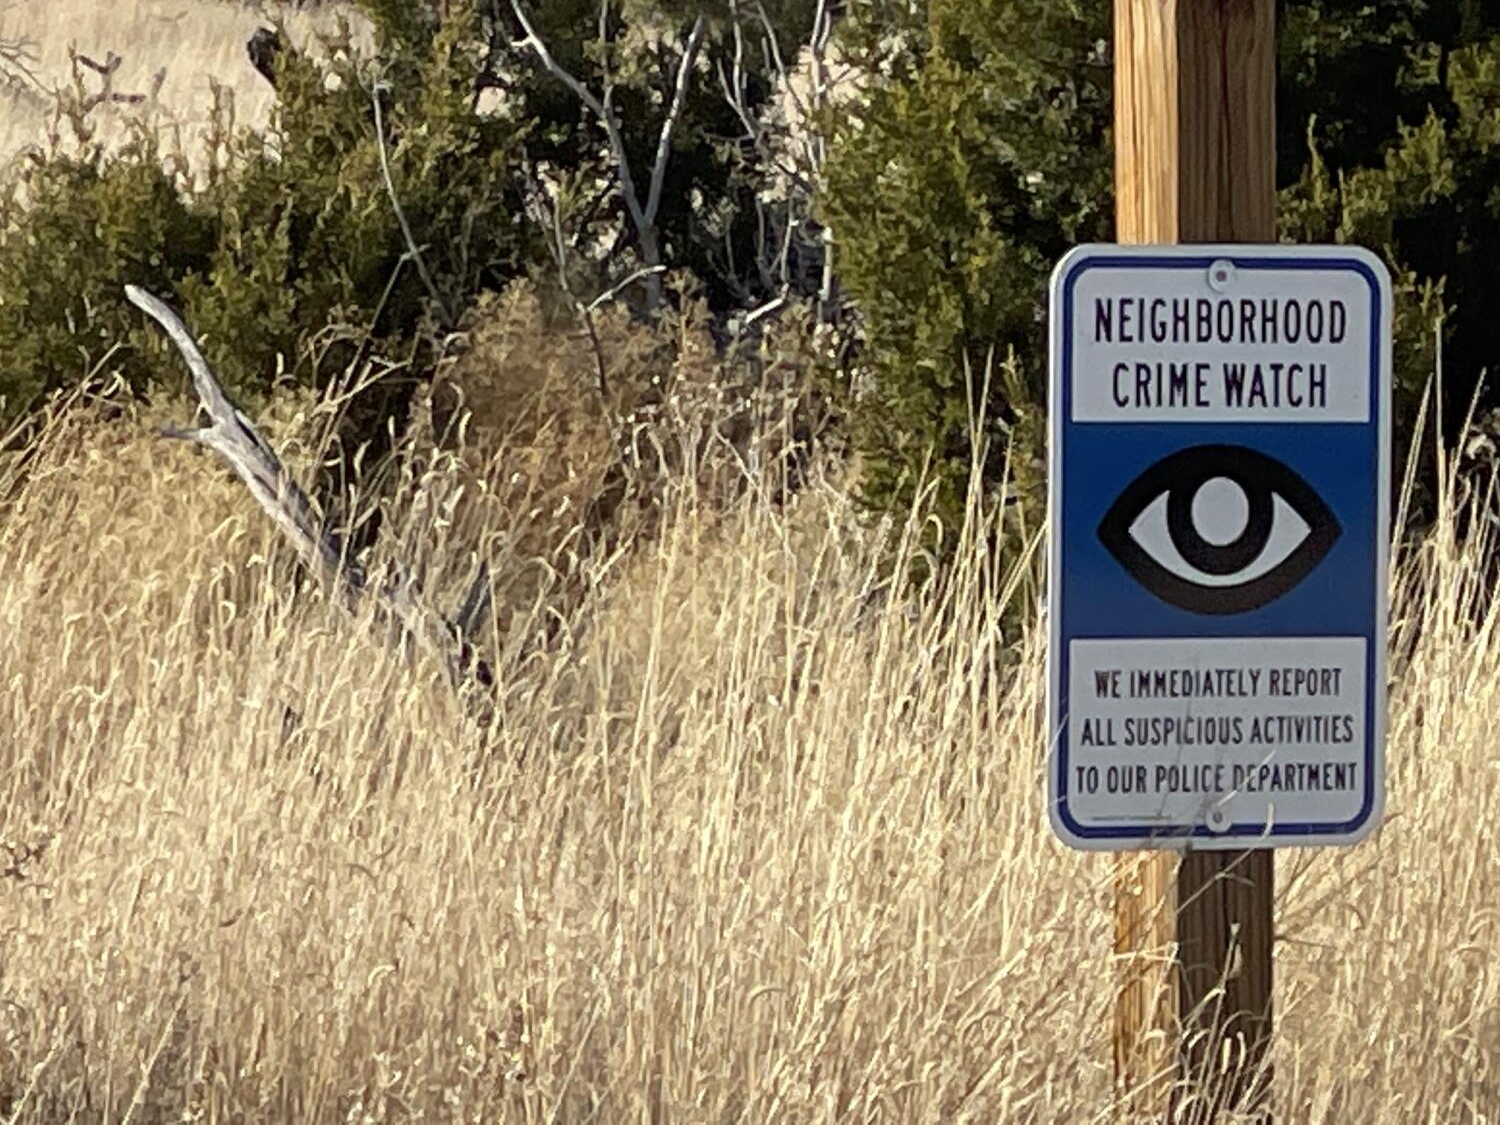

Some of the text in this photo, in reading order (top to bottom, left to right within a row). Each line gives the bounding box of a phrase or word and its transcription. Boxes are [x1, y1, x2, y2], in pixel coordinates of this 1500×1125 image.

[1095, 297, 1346, 344] NEIGHBORHOOD
[1112, 363, 1327, 408] CRIME WATCH
[1094, 667, 1342, 698] WE IMMEDIATELY REPORT
[1081, 714, 1354, 746] ALL SUSPICIOUS ACTIVITIES
[1077, 761, 1357, 794] TO OUR POLICE DEPARTMENT
